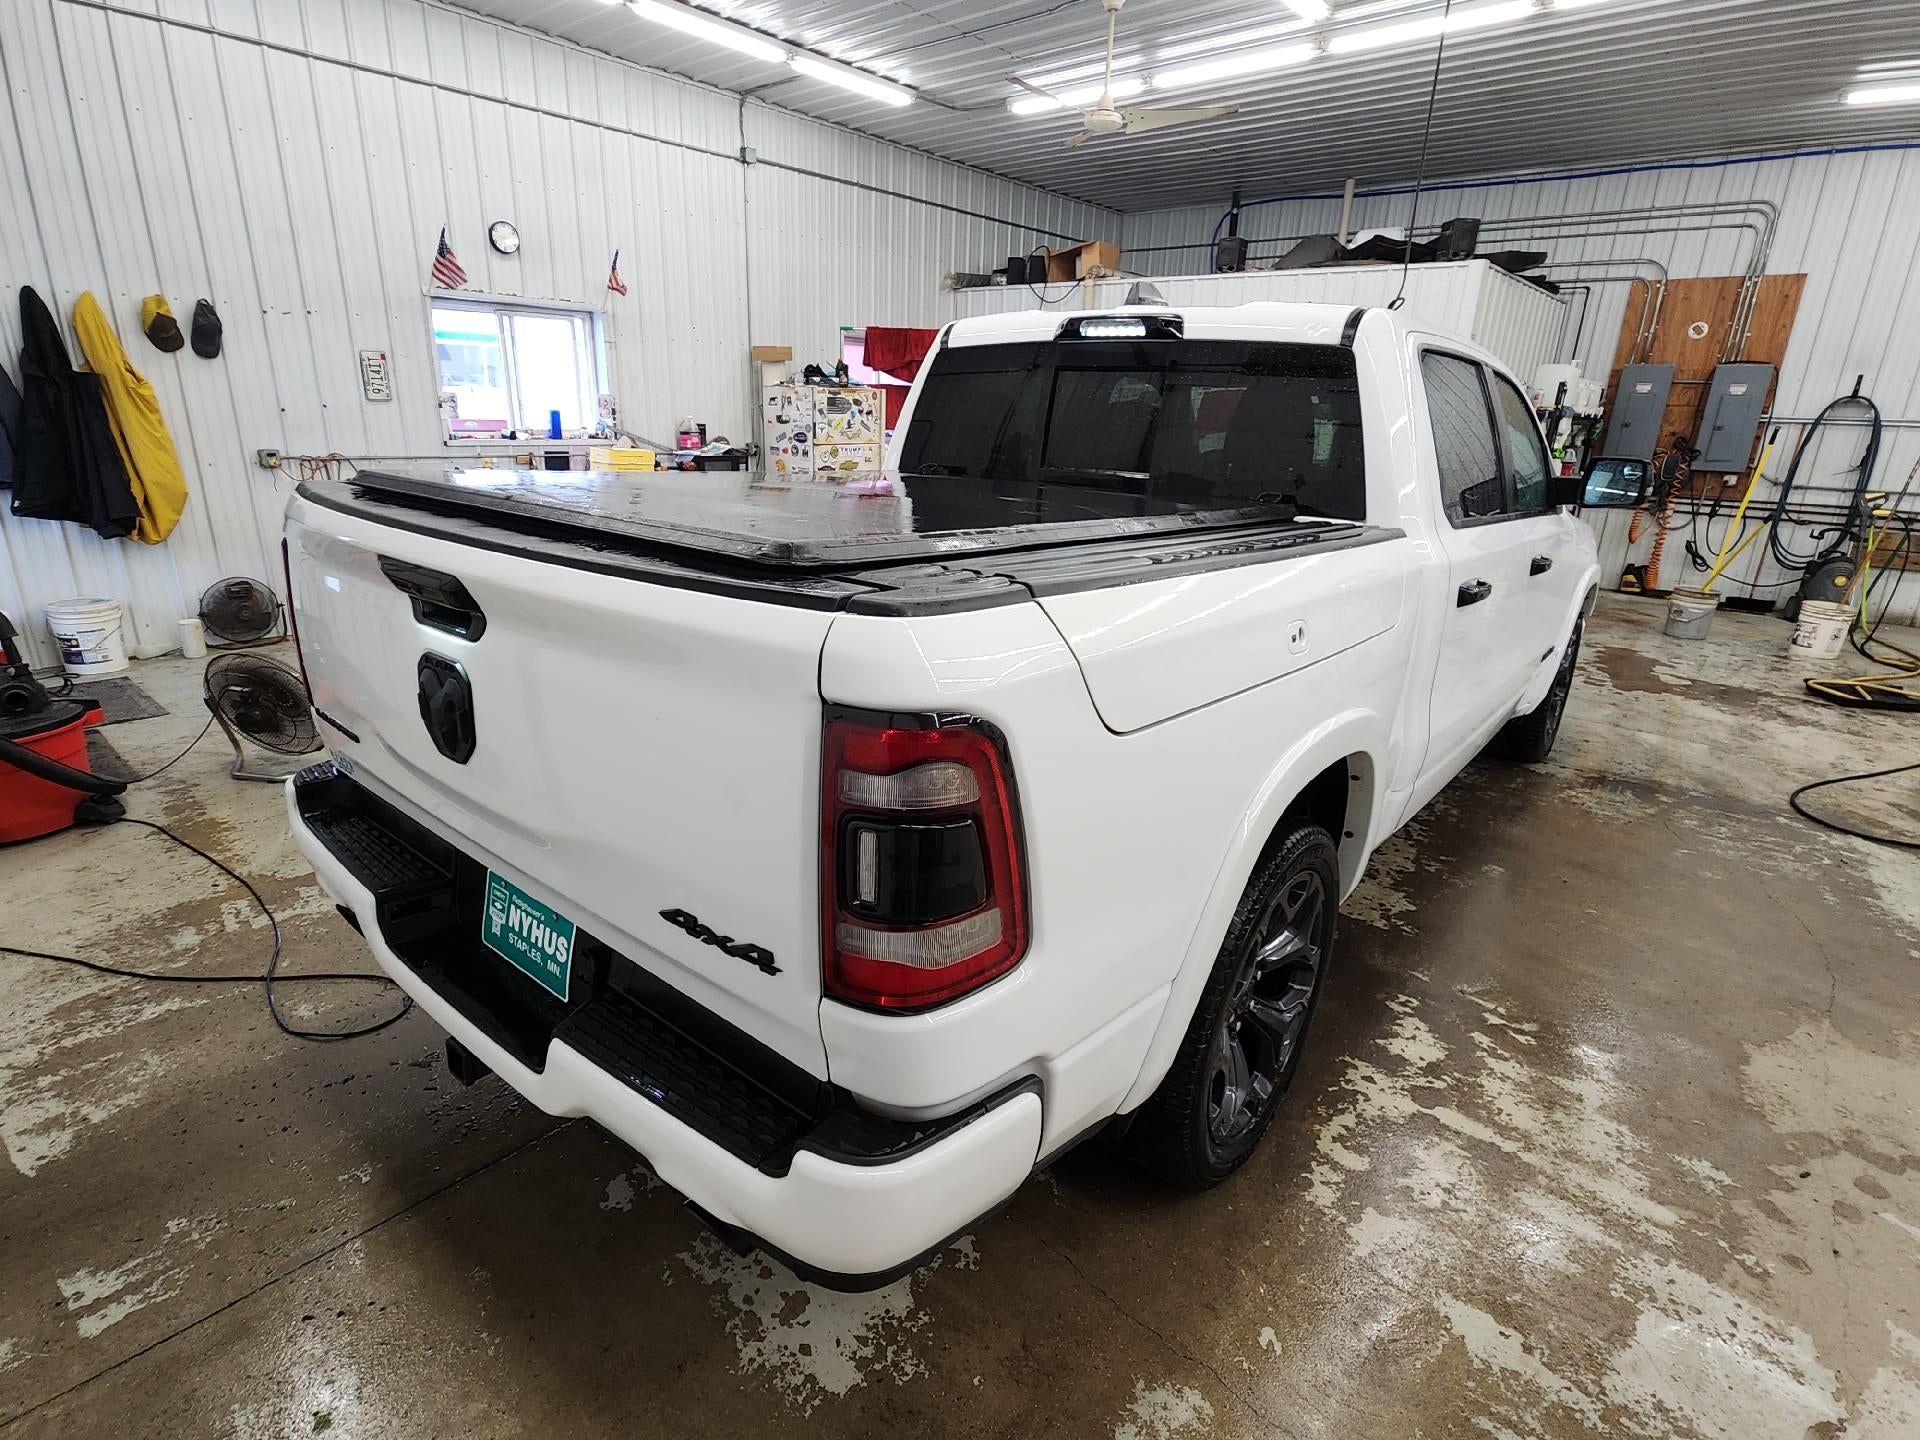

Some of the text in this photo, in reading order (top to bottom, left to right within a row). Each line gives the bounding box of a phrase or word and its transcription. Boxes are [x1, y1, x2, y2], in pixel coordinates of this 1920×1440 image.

[508, 904, 569, 963] NYHUS
[508, 933, 562, 978] STAPLES, MN.
